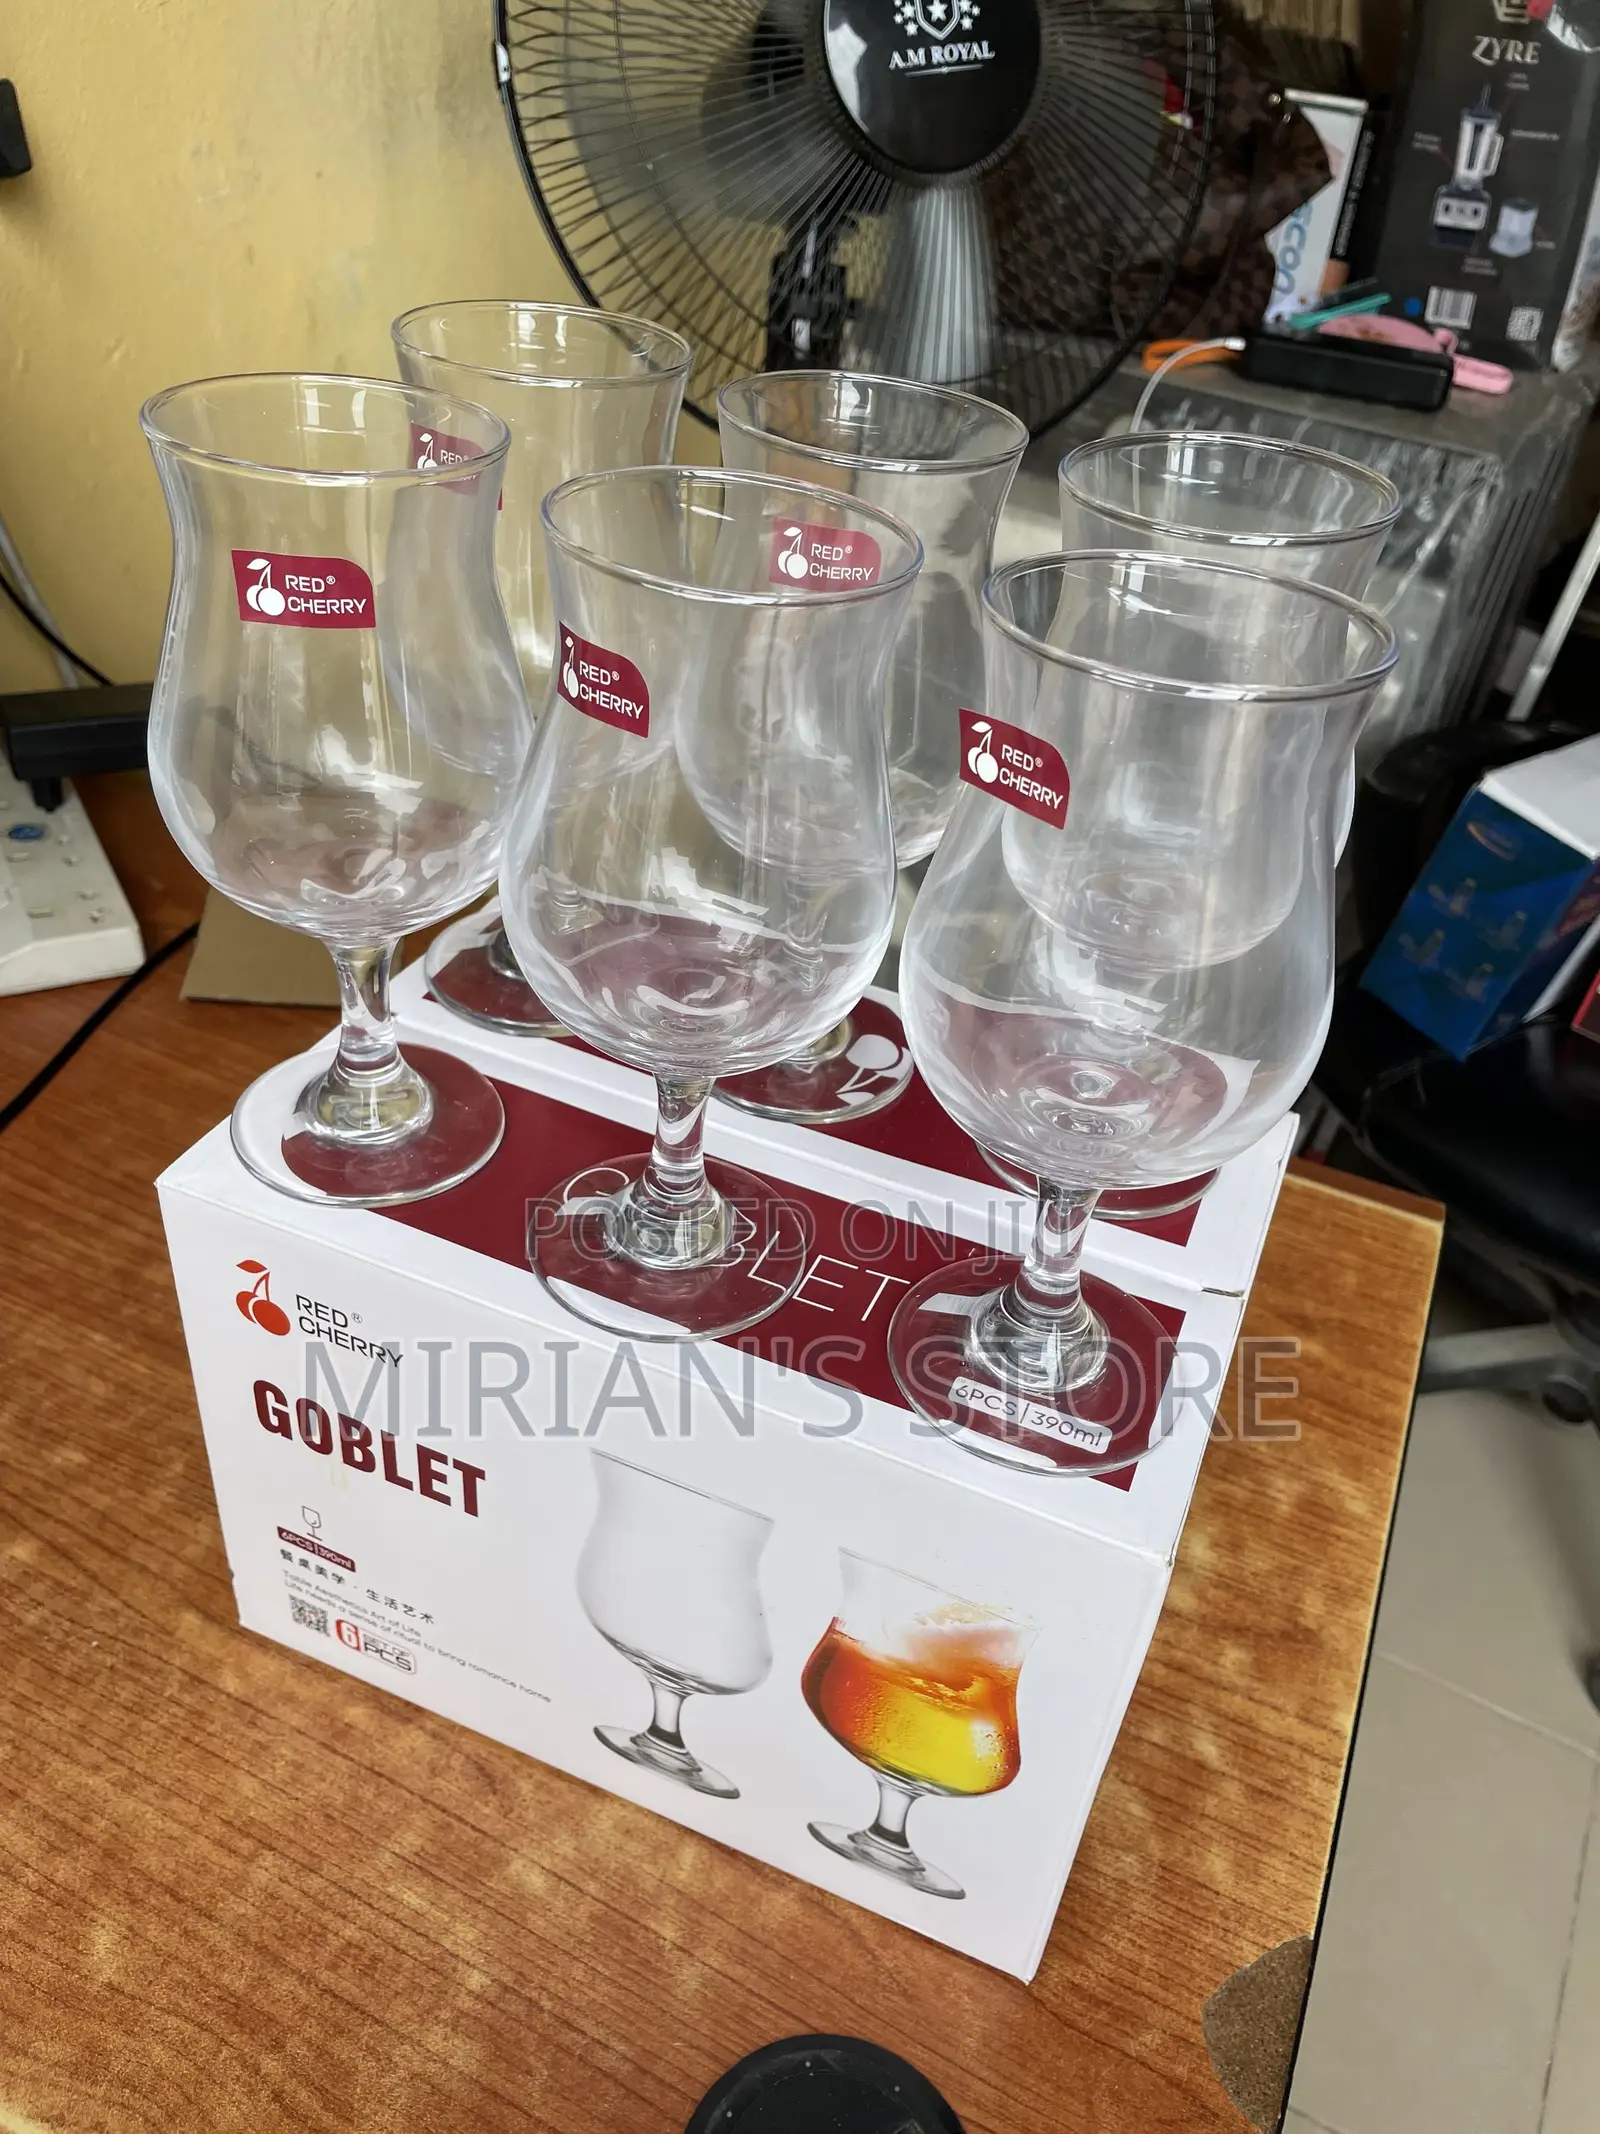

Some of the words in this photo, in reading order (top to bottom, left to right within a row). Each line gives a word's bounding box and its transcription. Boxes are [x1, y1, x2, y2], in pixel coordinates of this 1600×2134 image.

[931, 40, 995, 64] ROYAL
[1472, 35, 1541, 66] ZYRE
[809, 563, 874, 581] CHERRY
[287, 596, 367, 615] CHERRY
[579, 683, 644, 720] CHERRY
[999, 767, 1064, 810] CHERRY
[298, 1315, 404, 1368] CHERRY
[253, 1379, 486, 1518] GOBLET
[364, 1641, 412, 1672] PCS
[437, 1647, 466, 1668] bring
[468, 1662, 517, 1689] romance
[518, 1684, 551, 1703] home
